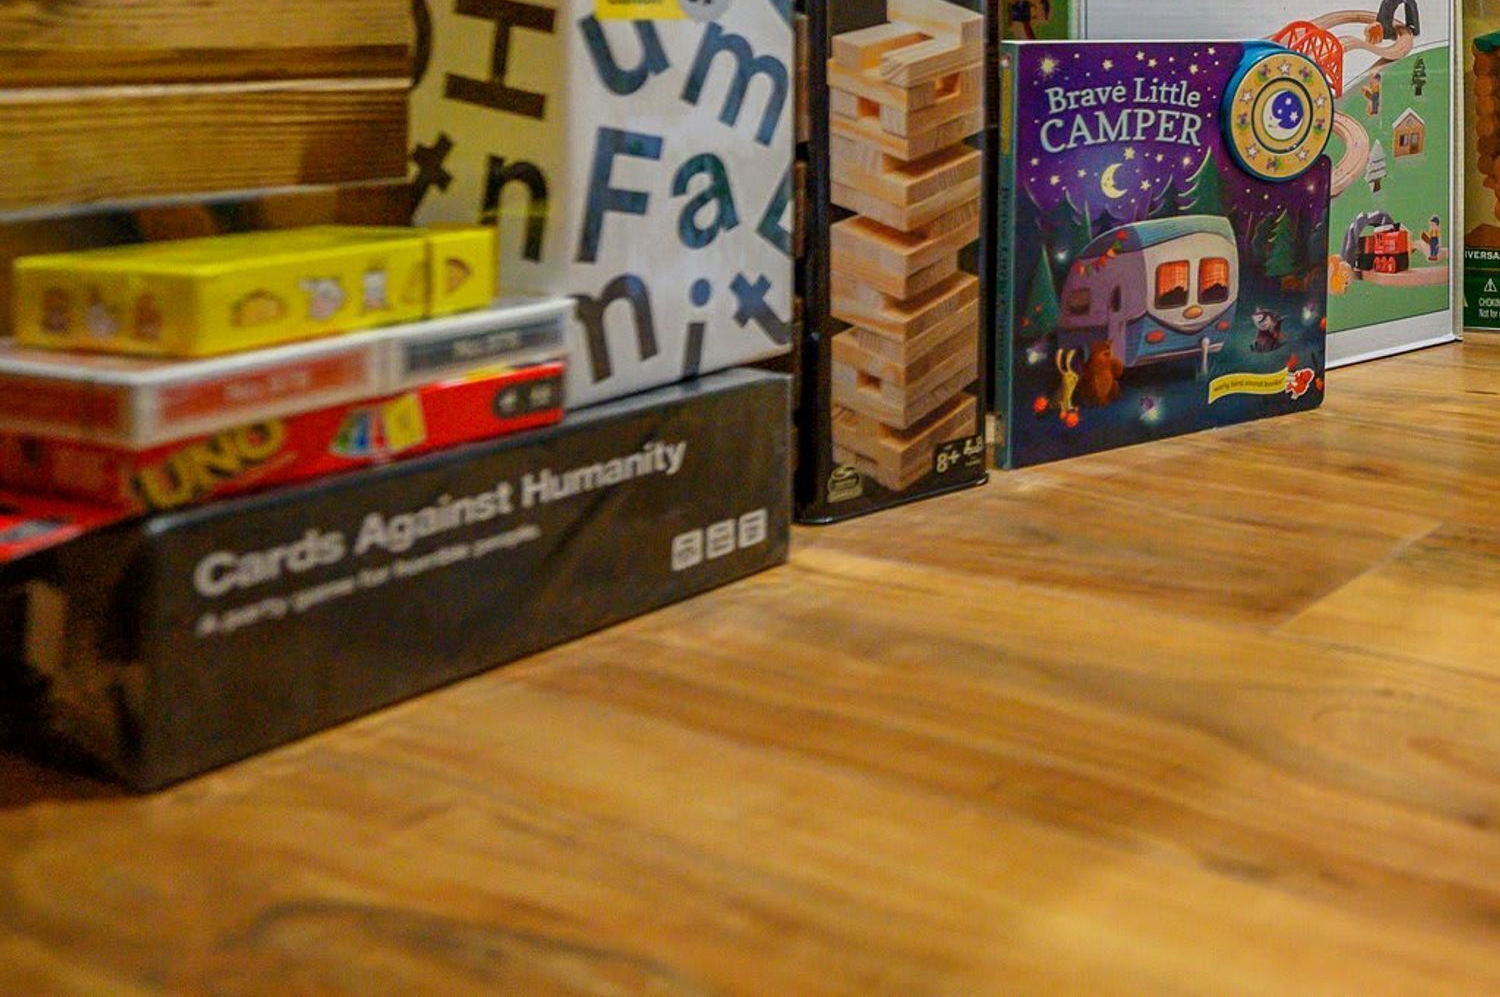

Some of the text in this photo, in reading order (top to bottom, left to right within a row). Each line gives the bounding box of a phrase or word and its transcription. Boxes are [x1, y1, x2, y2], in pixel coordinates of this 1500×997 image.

[1045, 77, 1201, 114] Brave Little
[1039, 108, 1202, 153] CAMPER
[936, 450, 960, 473] 8+
[193, 440, 688, 598] Cards Against Humanity
